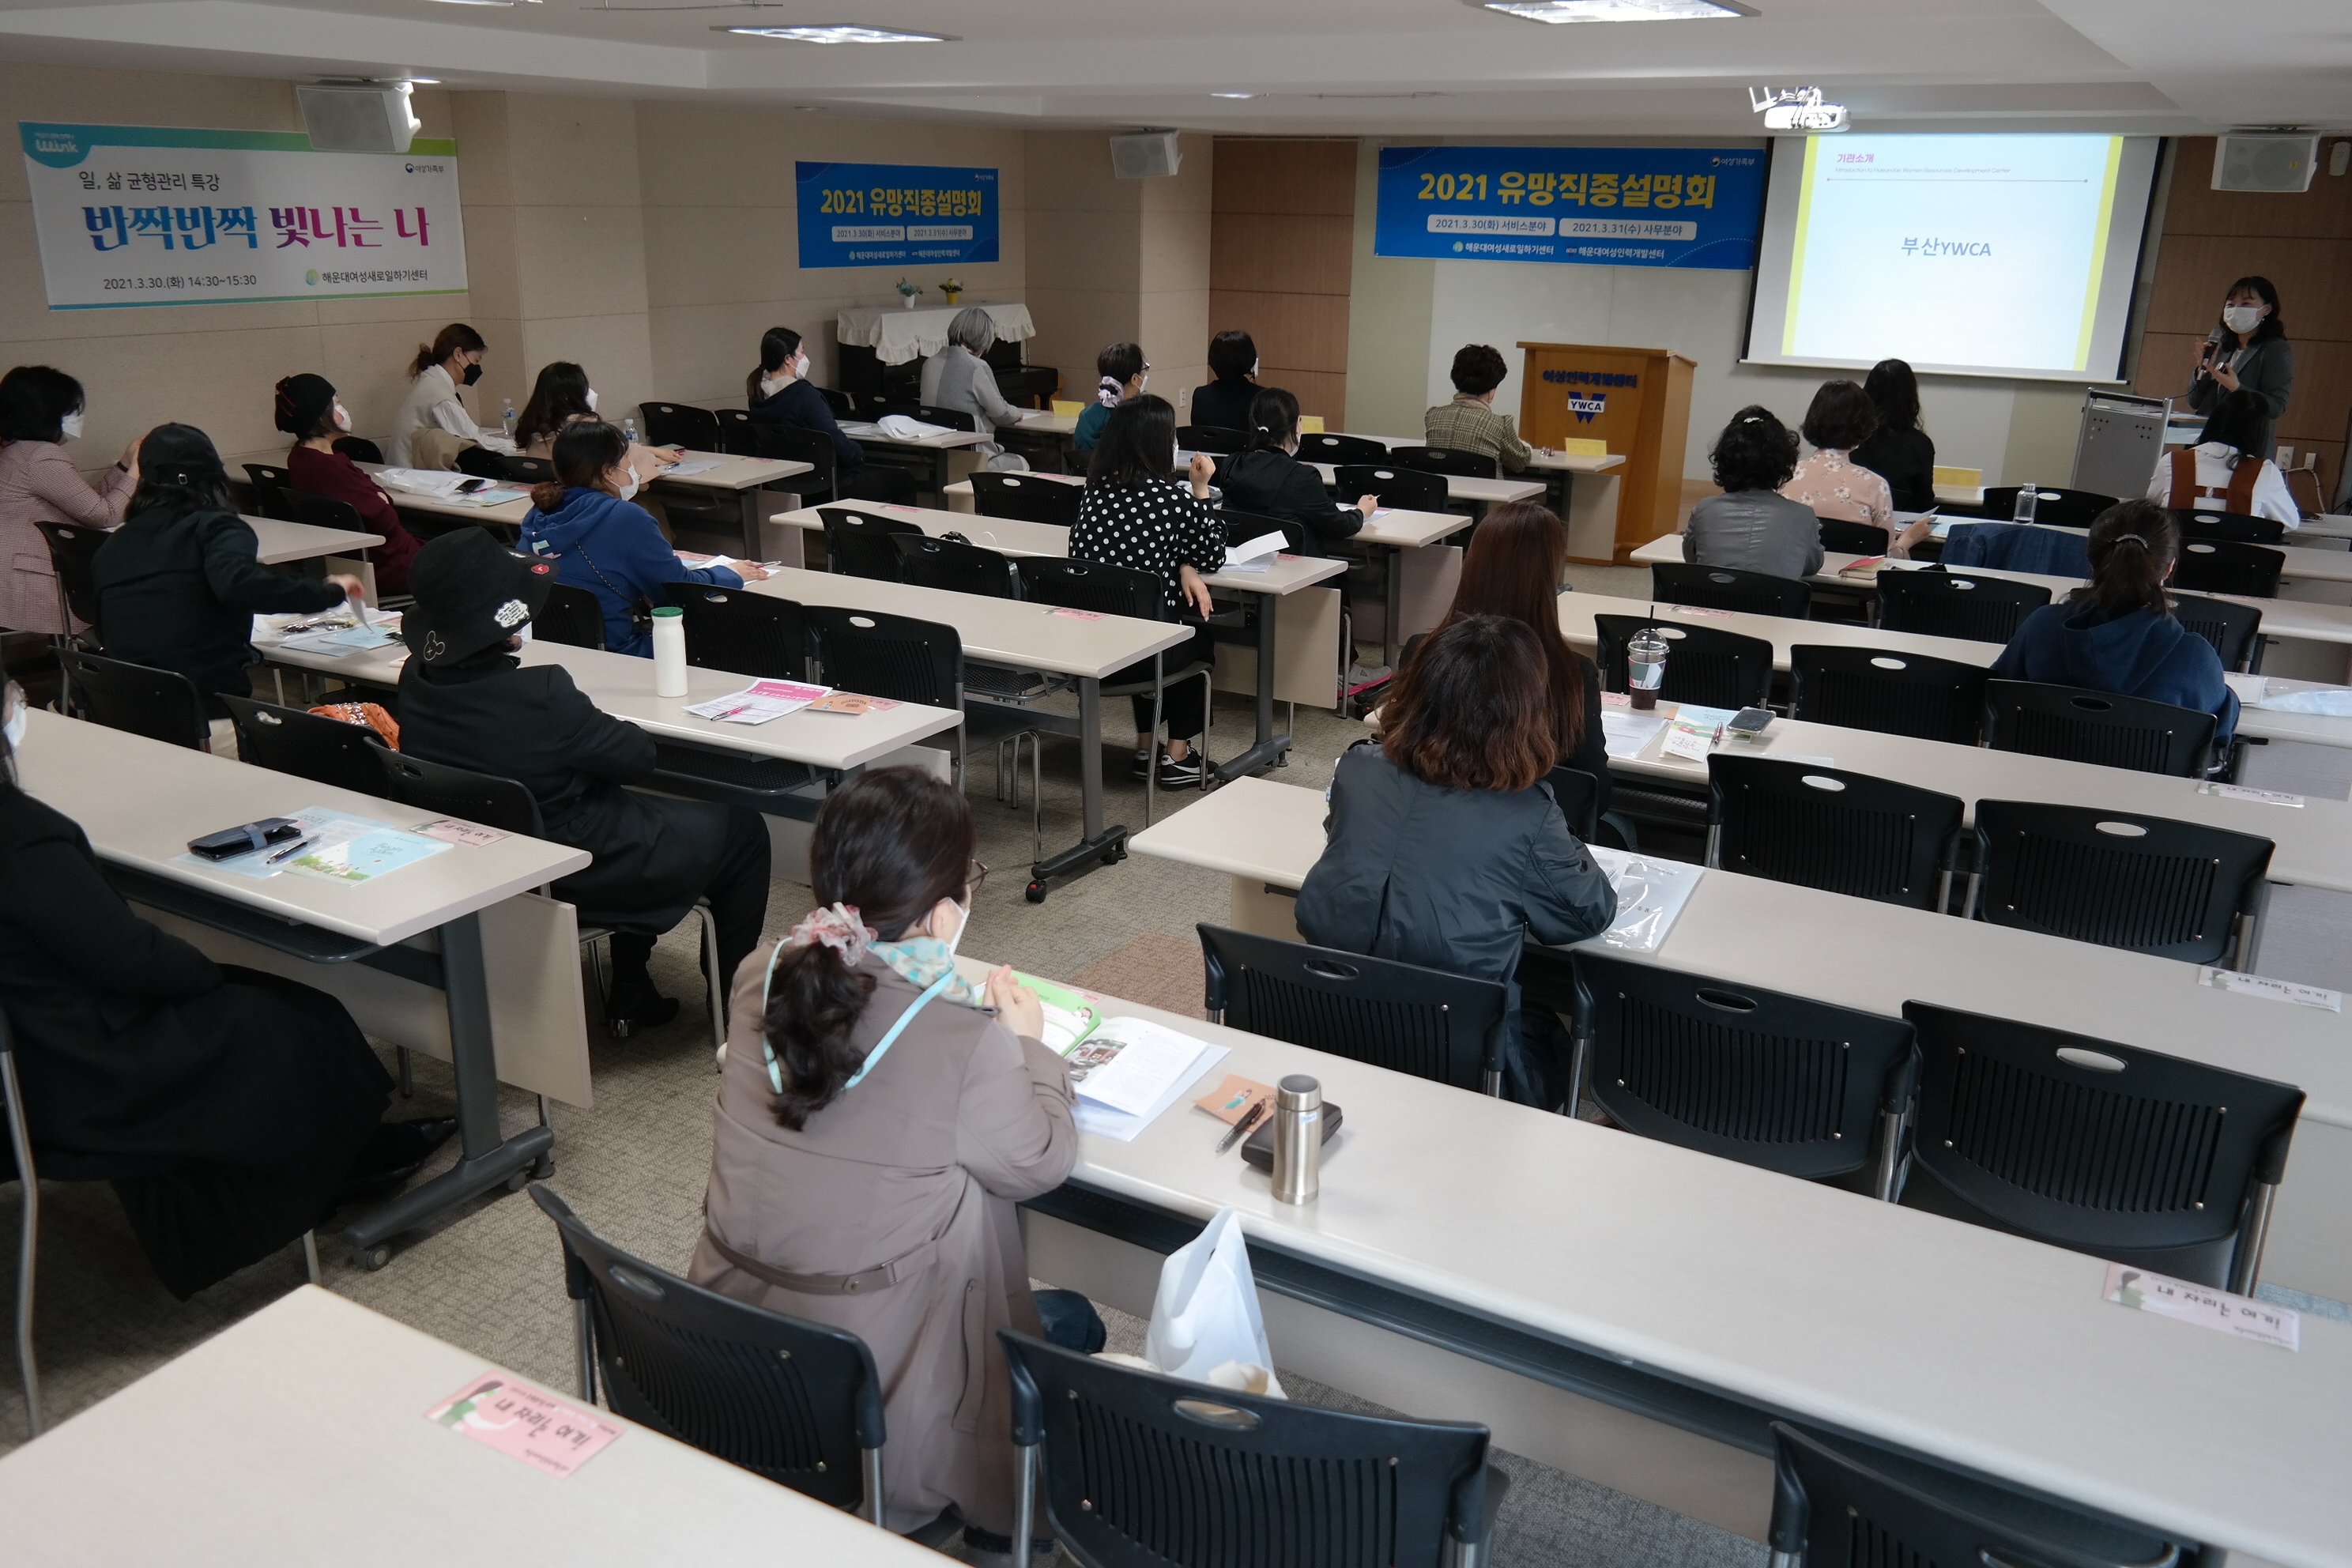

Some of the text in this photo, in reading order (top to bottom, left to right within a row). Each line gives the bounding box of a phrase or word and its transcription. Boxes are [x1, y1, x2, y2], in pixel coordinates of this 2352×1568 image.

[1721, 157, 1755, 167] 여성가족부
[1836, 153, 1874, 163] 기관소개
[415, 164, 444, 174] 여성가족부
[79, 171, 220, 192] 일, 삶 균형관리 특강
[1417, 171, 1715, 209] 2021 유망직종설명회
[820, 187, 982, 217] 2021 유망직종설명회
[81, 205, 430, 252] 반짝반짝 빛나는 나
[1434, 217, 1547, 233] 2021.3.30(화) 서비스분야
[1571, 221, 1683, 237] 2021.3.31(수) 사무분야
[1464, 241, 1554, 256] 해운대여성새로일하기센터
[1577, 245, 1665, 261] 해운대여성인력개발센터
[1901, 237, 1992, 257] 부산YWCA
[103, 274, 257, 290] 2021.3.30.(화) 14:30~15:30
[321, 269, 428, 285] 해운대여성새로일하기센터
[1570, 401, 1602, 411] YWCA
[2183, 1291, 2232, 1318] 자리는
